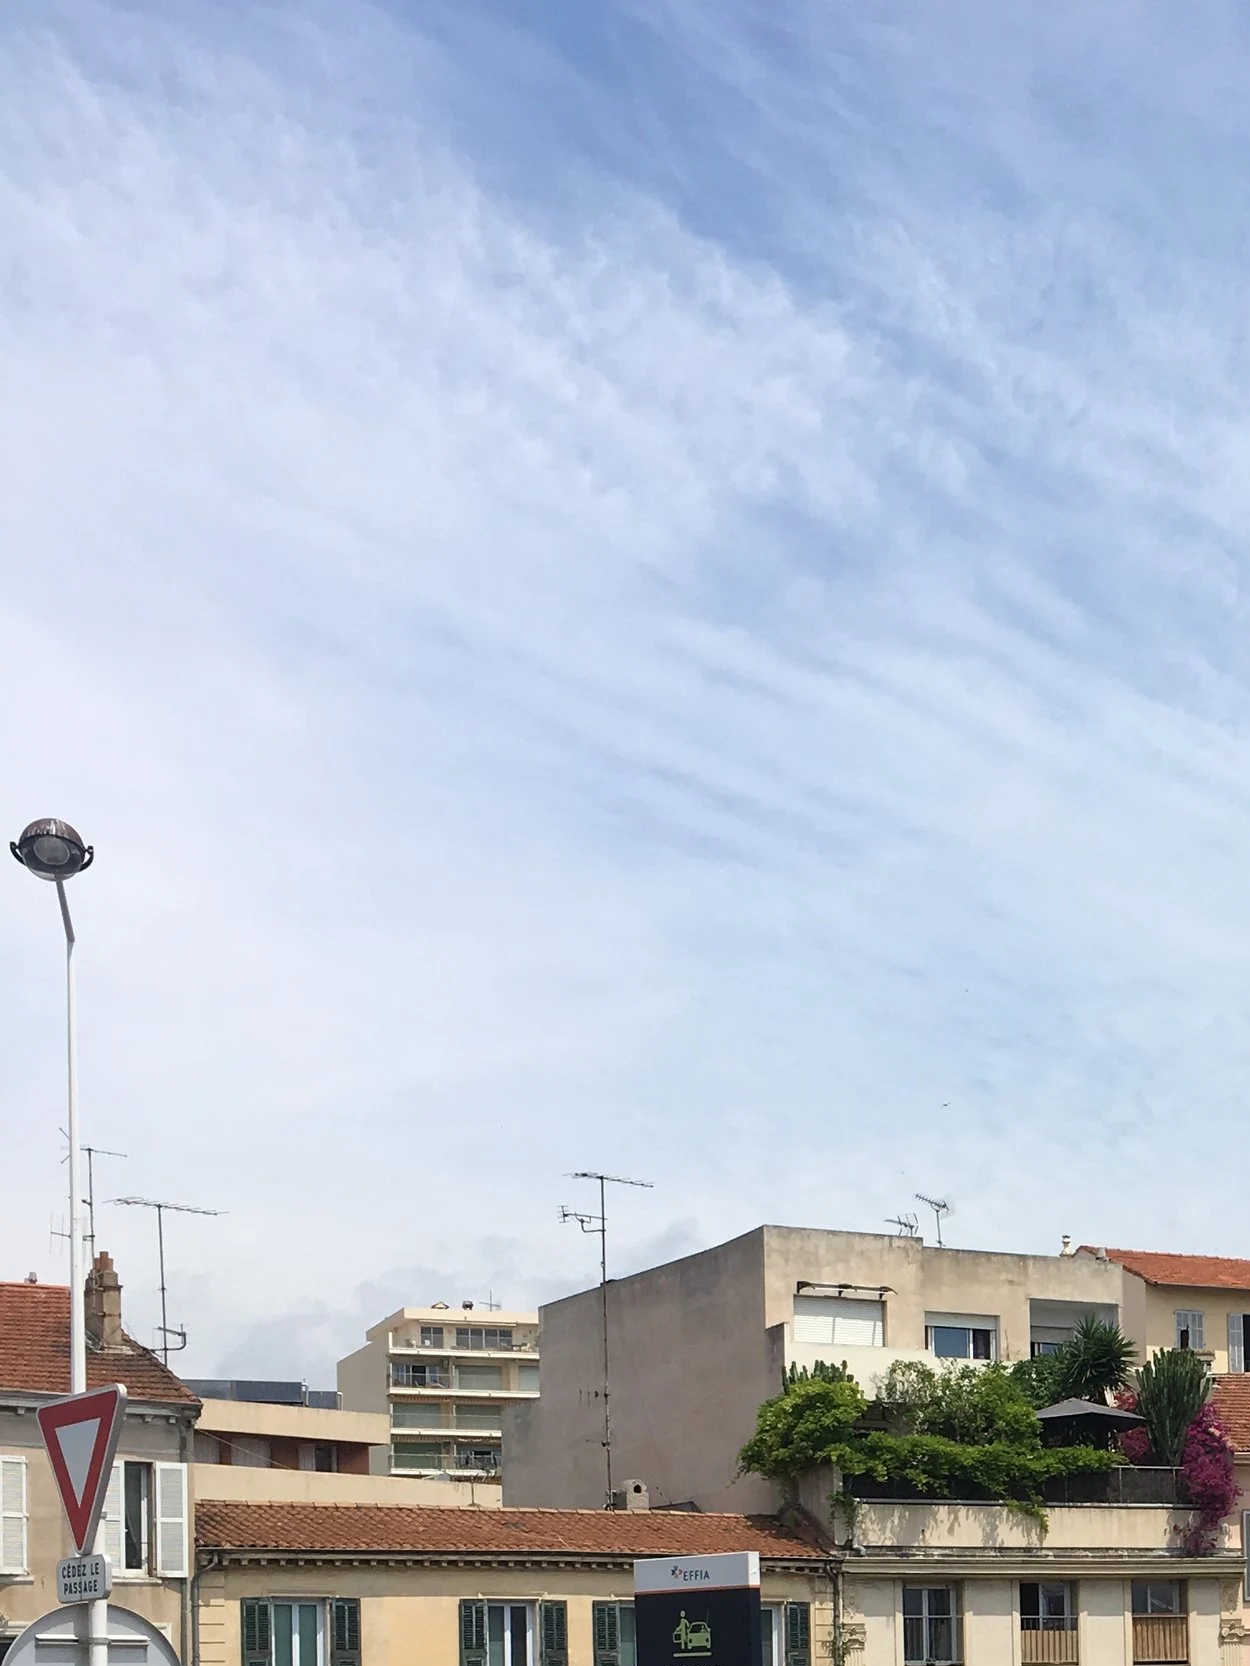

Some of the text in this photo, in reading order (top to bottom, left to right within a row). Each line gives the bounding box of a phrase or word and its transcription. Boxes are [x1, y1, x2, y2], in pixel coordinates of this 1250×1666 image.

[62, 1562, 100, 1579] CÉDEZ LE
[683, 1570, 710, 1581] EFFIA
[63, 1580, 98, 1595] PASSAGE
